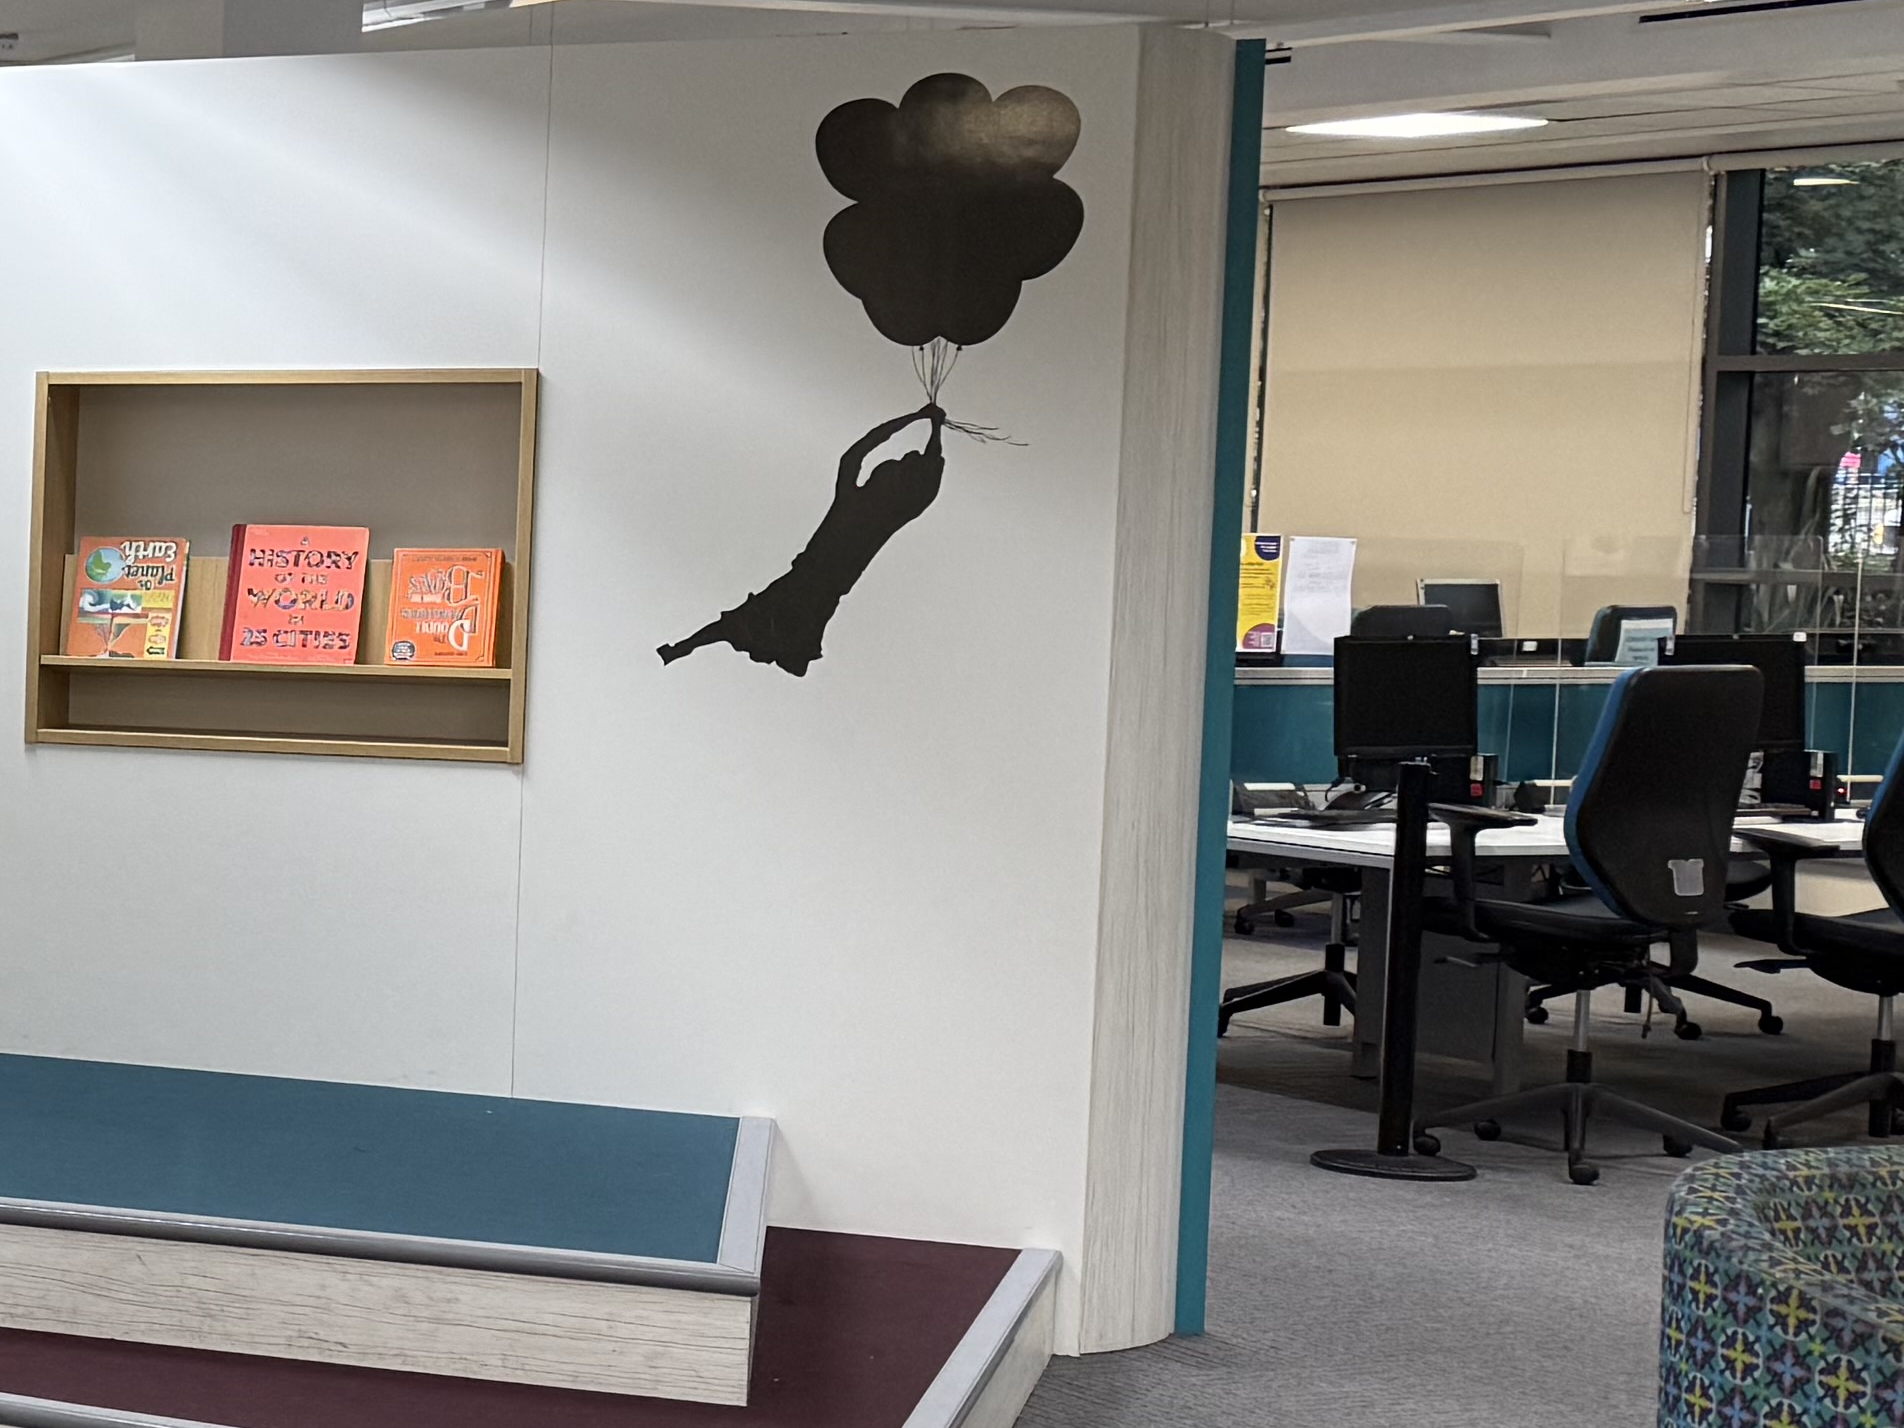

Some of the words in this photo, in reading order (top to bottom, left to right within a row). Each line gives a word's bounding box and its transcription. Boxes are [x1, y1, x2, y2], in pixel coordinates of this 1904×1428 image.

[121, 540, 177, 564] Earth
[249, 549, 359, 570] HISTORY
[122, 564, 176, 586] Planet
[275, 573, 293, 584] OF
[247, 588, 354, 611] WORLD
[240, 628, 267, 647] 25
[273, 630, 350, 650] CITIES
